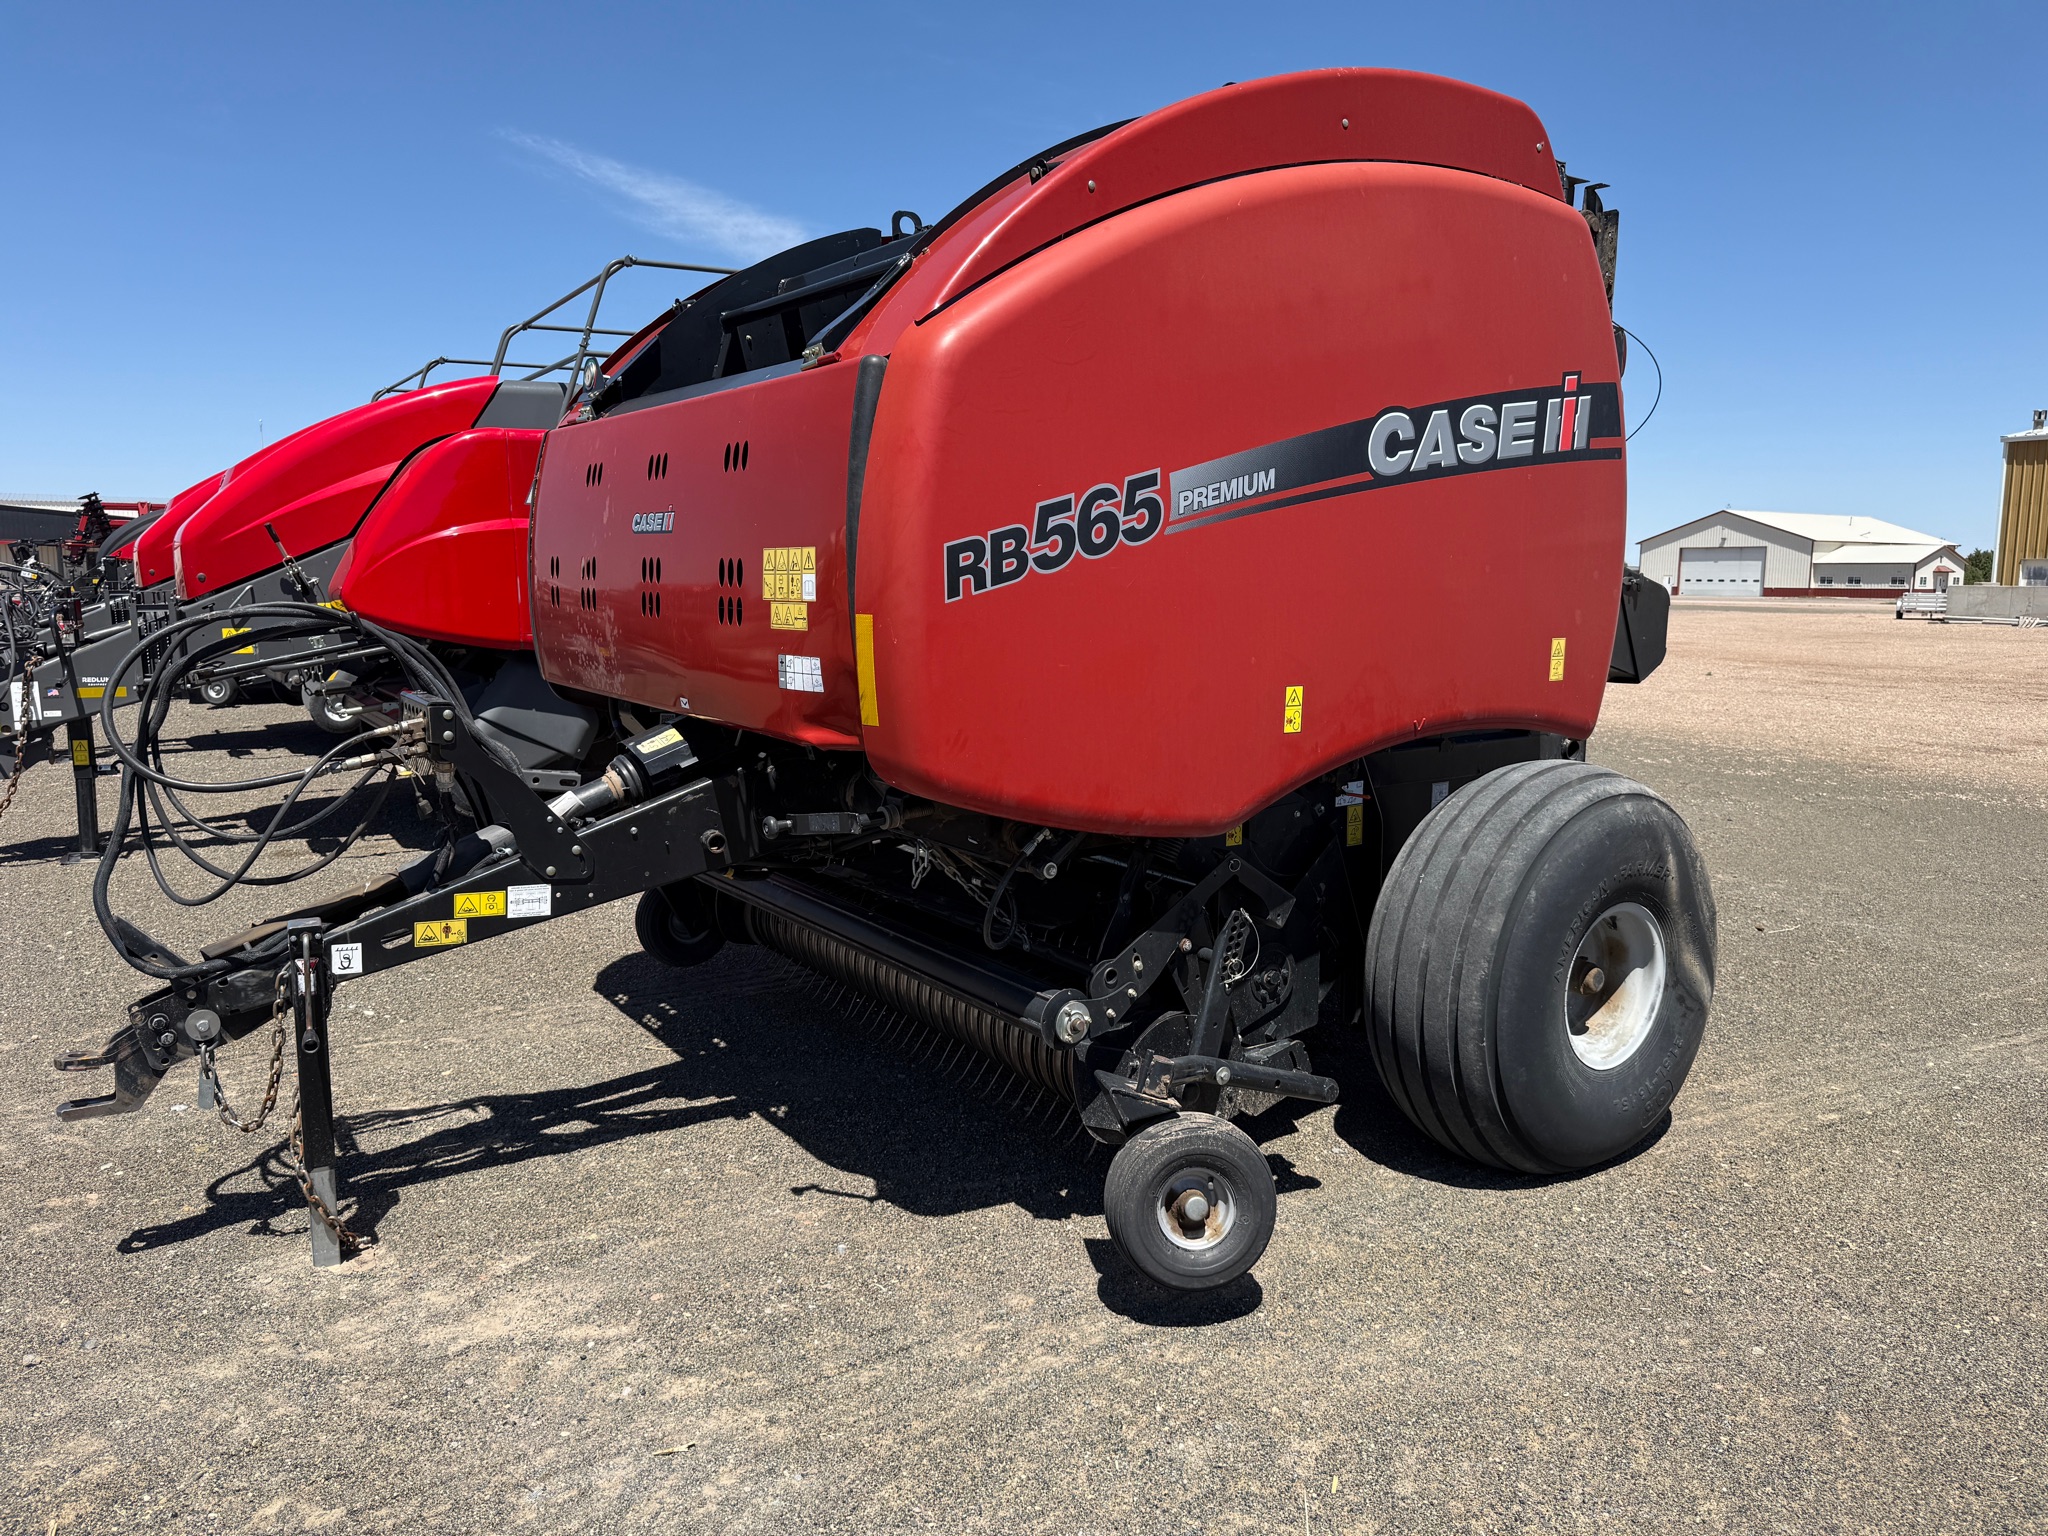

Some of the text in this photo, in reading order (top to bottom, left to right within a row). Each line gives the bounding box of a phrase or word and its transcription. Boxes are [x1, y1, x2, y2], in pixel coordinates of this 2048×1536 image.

[1368, 401, 1538, 476] CASE
[632, 512, 664, 532] CASE
[1178, 468, 1276, 515] PREMIUM
[944, 468, 1164, 604] RB565
[1553, 877, 1610, 984] AMERICAN
[1620, 861, 1670, 882] FARMER
